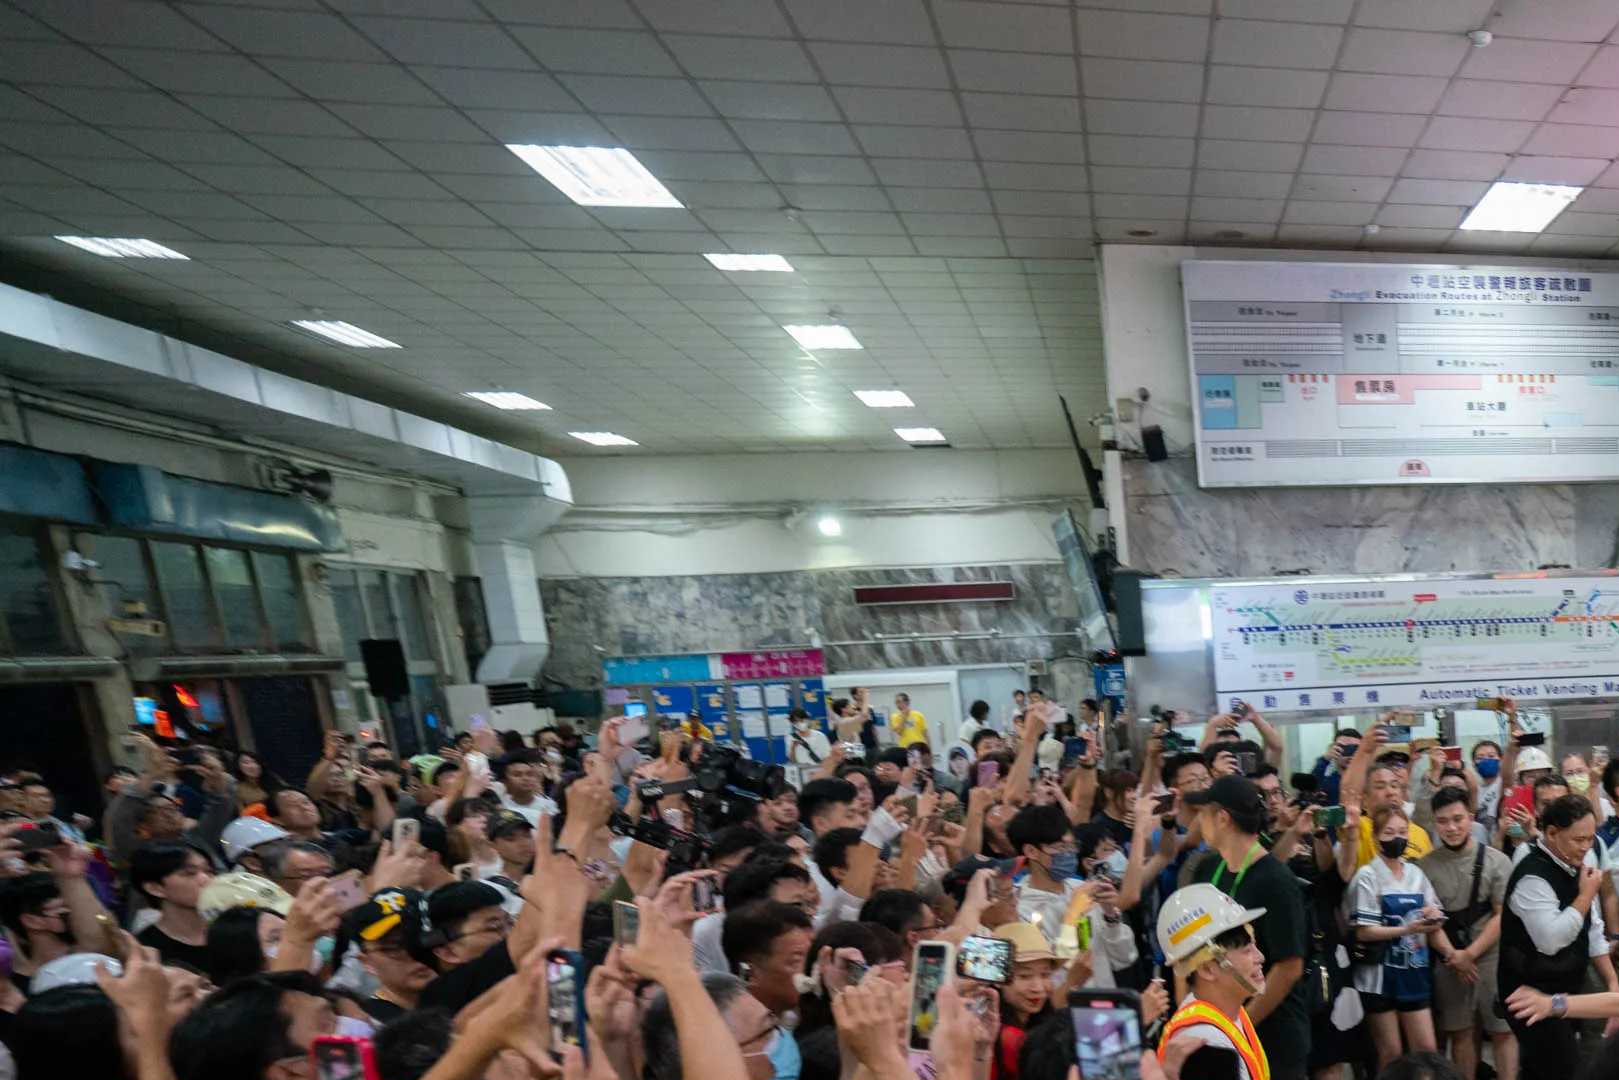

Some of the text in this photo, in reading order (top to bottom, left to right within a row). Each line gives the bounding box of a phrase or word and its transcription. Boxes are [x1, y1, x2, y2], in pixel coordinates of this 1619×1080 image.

[1376, 290, 1438, 300] Evacuation
[1441, 291, 1478, 300] Routes
[1481, 292, 1491, 300] at
[1496, 291, 1538, 303] Zhongli
[1542, 294, 1580, 302] Station
[1420, 686, 1490, 700] Automatic
[1496, 684, 1538, 697] Ticket
[1544, 682, 1598, 696] Vending
